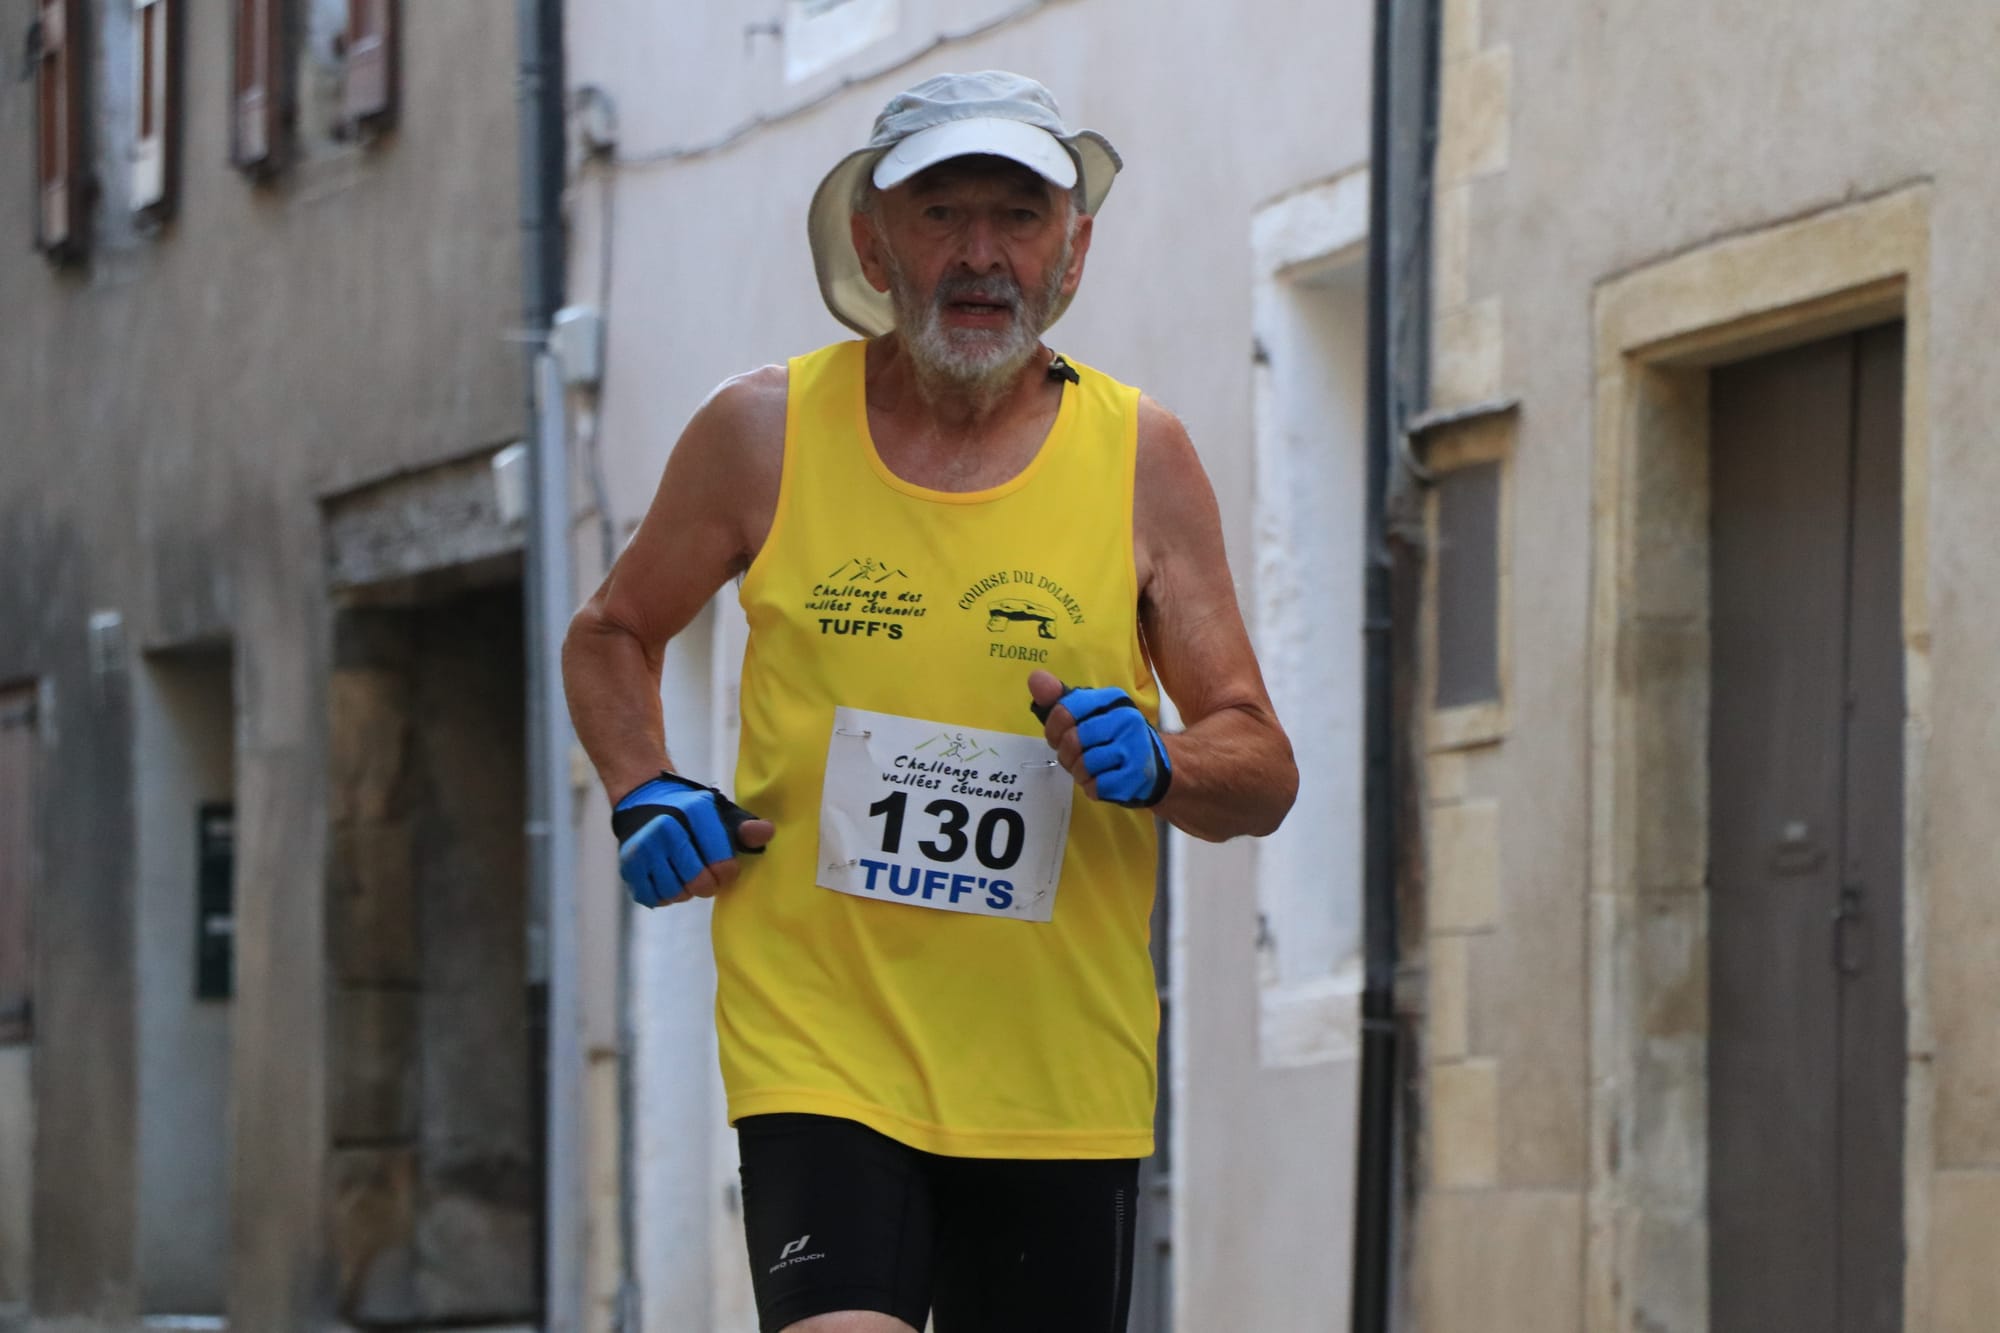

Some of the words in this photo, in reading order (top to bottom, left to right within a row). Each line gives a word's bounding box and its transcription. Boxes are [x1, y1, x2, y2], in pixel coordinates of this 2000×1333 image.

[805, 599, 852, 611] vallées
[861, 602, 927, 617] cévenoles
[812, 584, 888, 603] Challenge
[897, 591, 923, 602] des
[958, 571, 1009, 610] COURSE
[1013, 570, 1034, 585] DU
[1037, 575, 1085, 625] DOLMEN
[818, 618, 904, 640] TUFF'S
[989, 643, 1048, 663] FLORAC
[894, 755, 979, 783] Challenge
[988, 771, 1018, 785] des
[882, 772, 941, 790] vallées
[951, 781, 1024, 802] cévenoles
[869, 790, 1026, 871] 130
[860, 858, 1014, 910] TUFF'S
